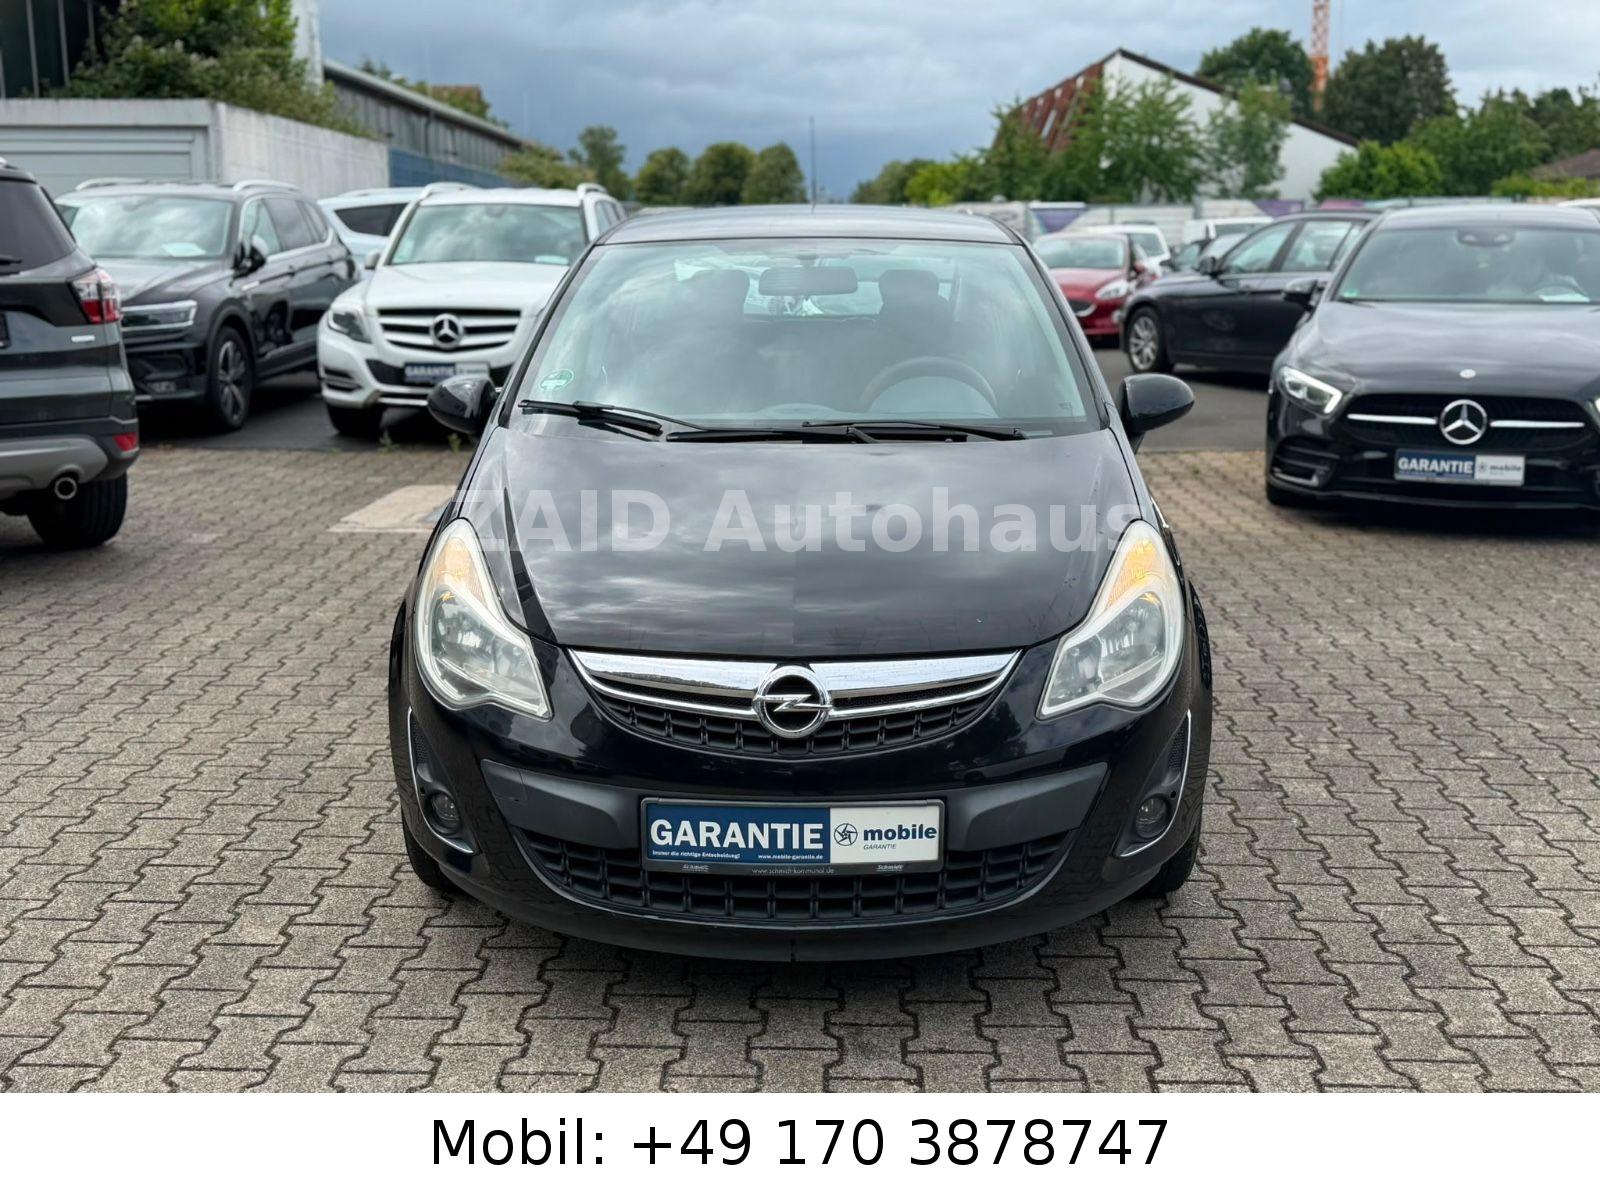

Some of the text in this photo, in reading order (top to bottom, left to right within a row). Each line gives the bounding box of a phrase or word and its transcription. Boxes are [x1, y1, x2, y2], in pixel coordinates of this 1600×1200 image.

[1397, 458, 1475, 474] GARANTIE
[650, 819, 824, 850] GARANTIE
[863, 824, 938, 841] mobile
